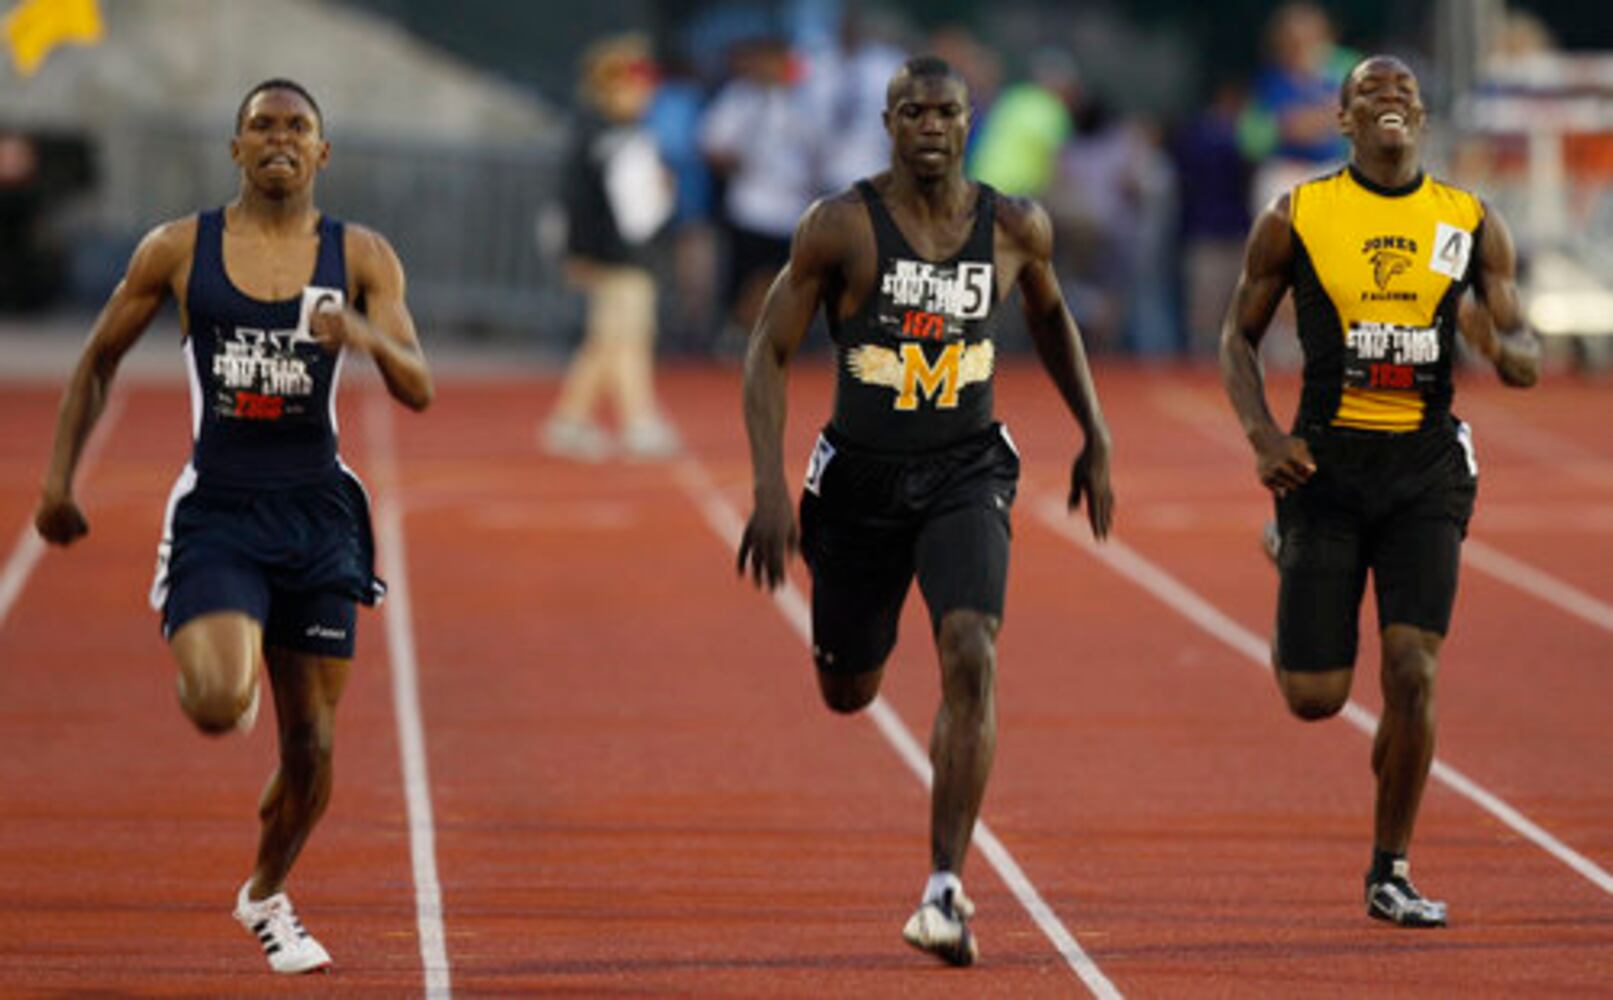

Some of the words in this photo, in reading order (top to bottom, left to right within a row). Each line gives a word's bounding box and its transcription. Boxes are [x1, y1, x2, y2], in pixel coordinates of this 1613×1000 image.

[1362, 236, 1417, 252] JONES
[1439, 231, 1463, 273] 4
[963, 267, 984, 314] 5
[1361, 292, 1417, 301] FALCONS
[895, 343, 964, 410] M
